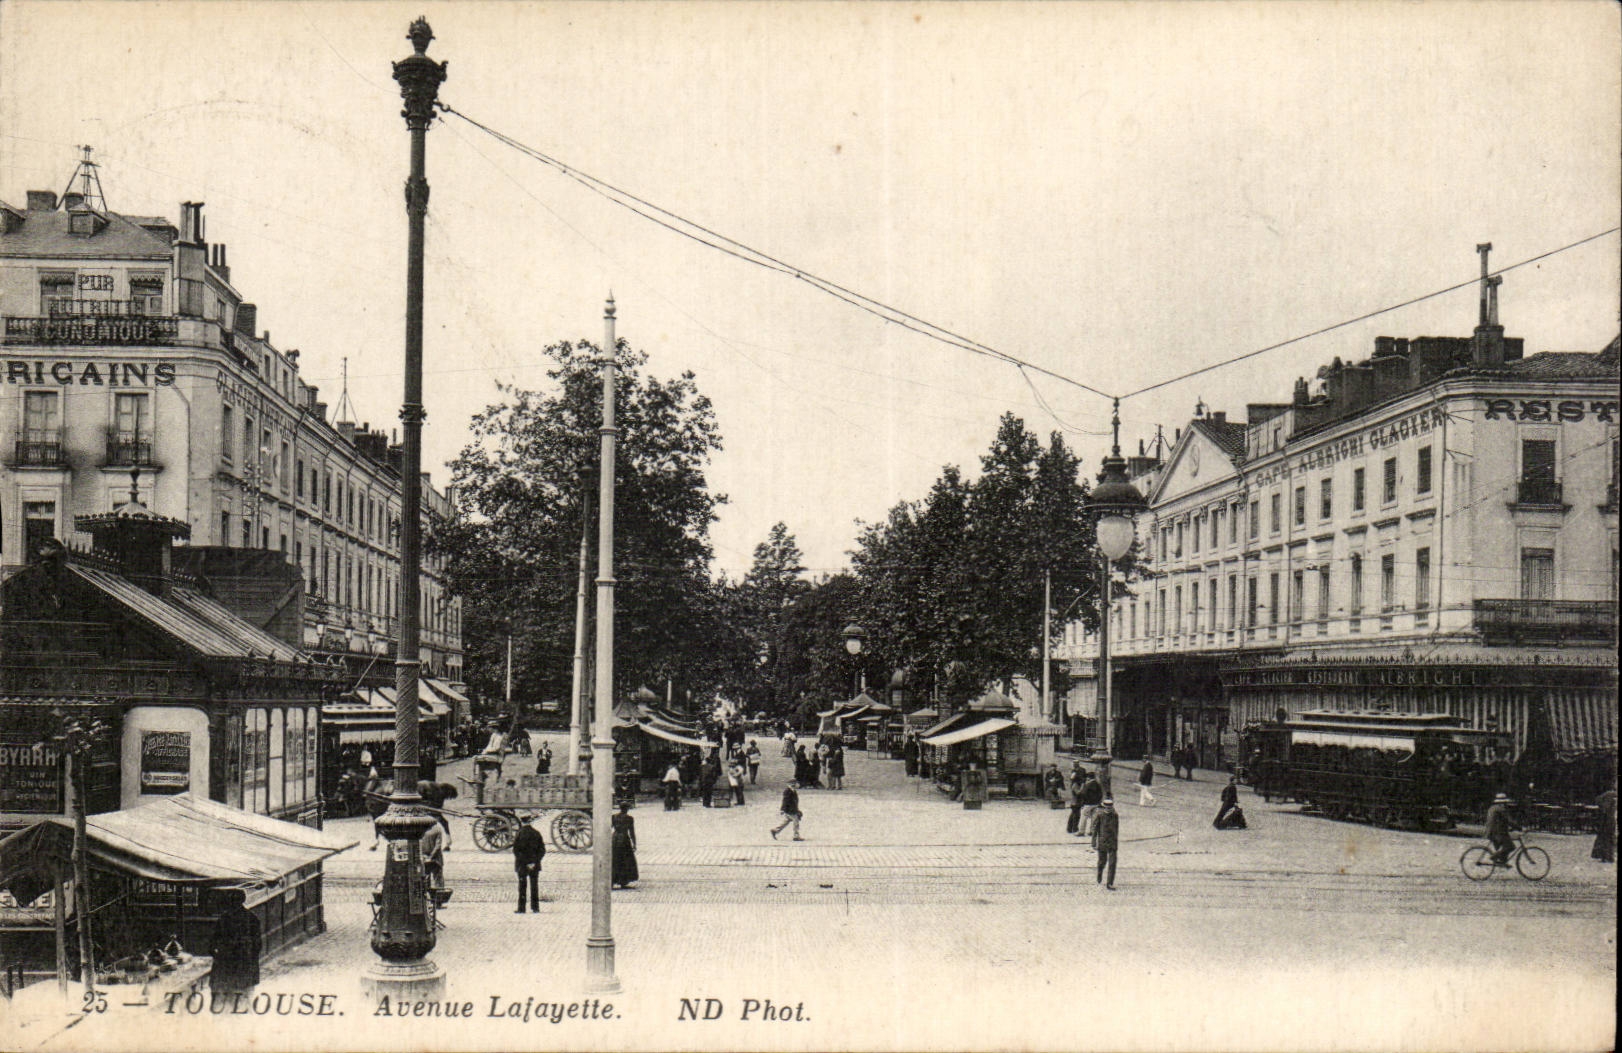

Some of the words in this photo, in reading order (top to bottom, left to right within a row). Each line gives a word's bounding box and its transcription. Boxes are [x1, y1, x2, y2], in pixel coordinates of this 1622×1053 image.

[0, 361, 176, 386] RICAINS
[1485, 400, 1619, 422] REST
[1369, 407, 1443, 450] GLACIER
